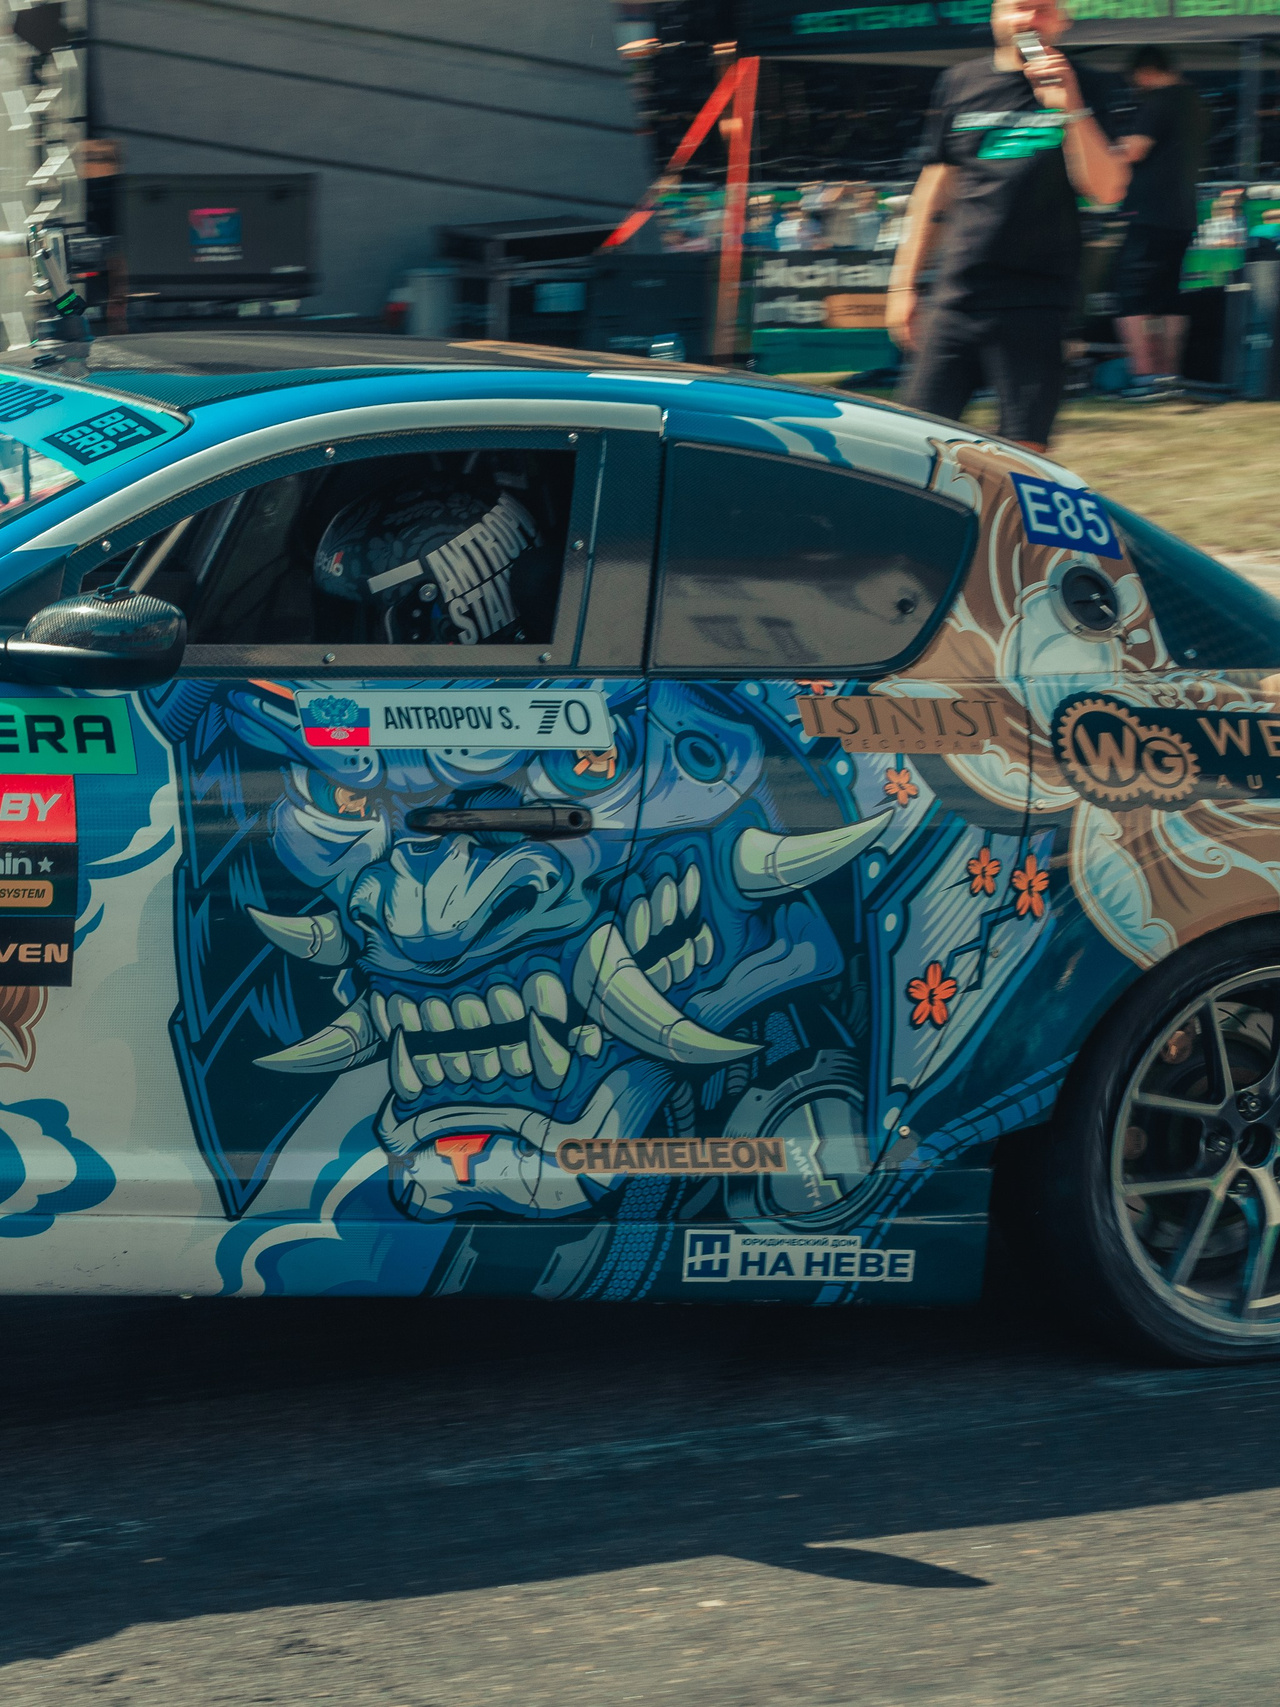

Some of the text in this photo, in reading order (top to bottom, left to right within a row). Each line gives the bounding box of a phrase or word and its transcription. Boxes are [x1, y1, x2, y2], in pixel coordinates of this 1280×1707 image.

[89, 410, 153, 443] BET
[1019, 483, 1110, 546] E85
[383, 699, 592, 736] ANTROPOV S. 70
[800, 697, 999, 738] TSINIST
[1075, 723, 1184, 785] WG
[1216, 774, 1280, 790] AU
[560, 1141, 784, 1171] CHAMELEON
[741, 1237, 858, 1249] ЮРИДИЧЕСКИЙ ДОМ
[739, 1251, 911, 1278] НА НЕВЕ
